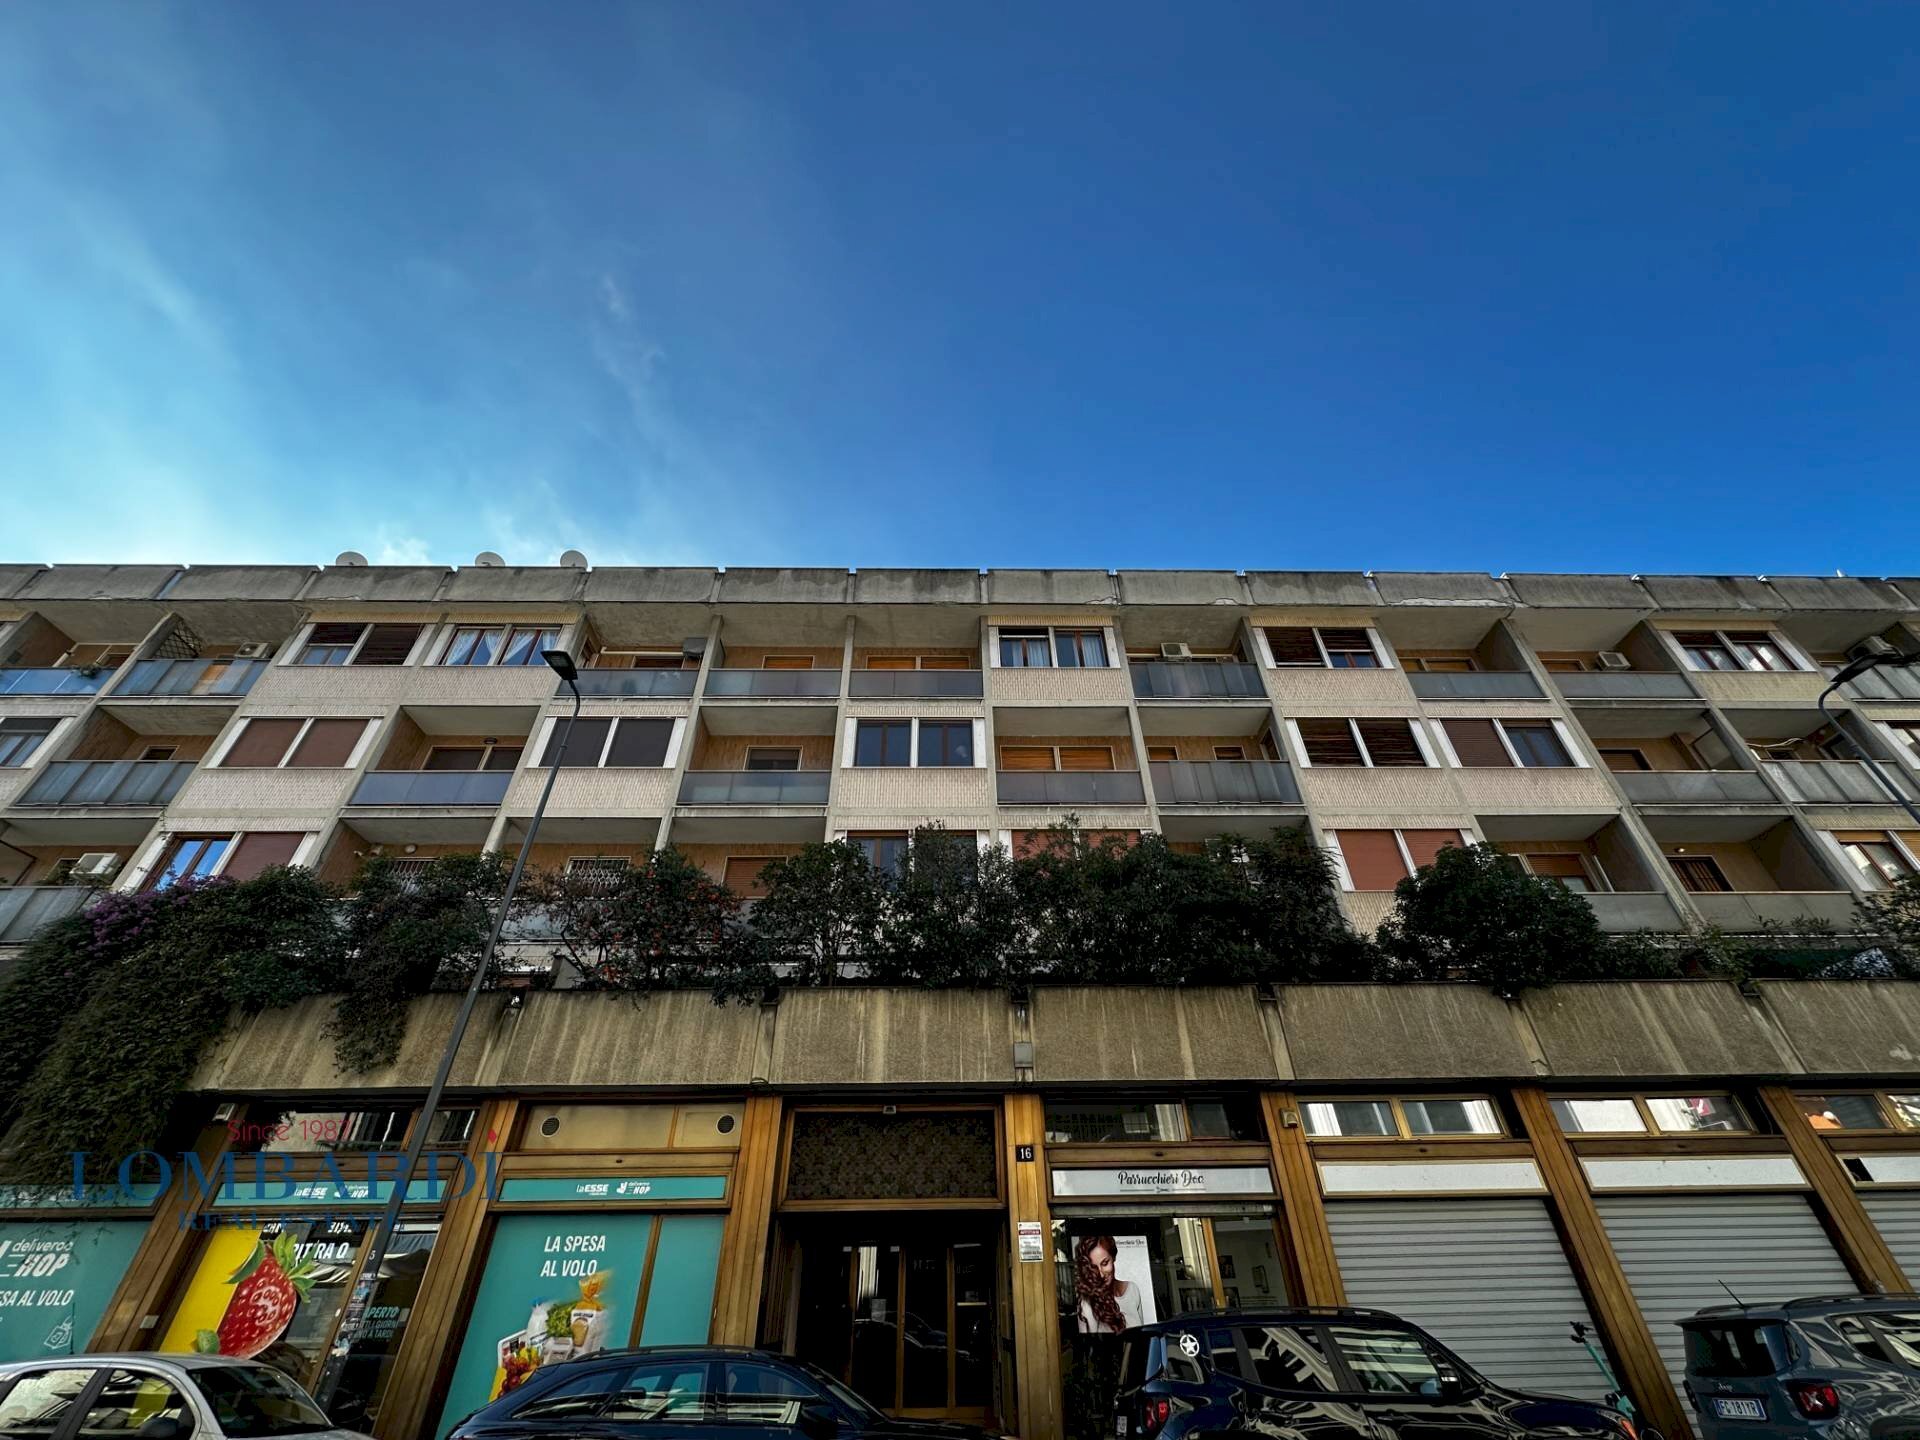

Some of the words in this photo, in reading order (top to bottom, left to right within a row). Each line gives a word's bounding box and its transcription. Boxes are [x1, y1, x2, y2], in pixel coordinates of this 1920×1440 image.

[1020, 1147, 1032, 1159] 16
[1117, 1171, 1178, 1186] Parrucchieri
[633, 1186, 651, 1195] HOP
[12, 1238, 74, 1253] deliveroo
[544, 1236, 561, 1252] LA
[563, 1235, 606, 1252] SPESA
[13, 1253, 71, 1277] HOP
[540, 1260, 557, 1277] AL
[562, 1259, 597, 1277] VOLO
[16, 1289, 36, 1306] AL
[36, 1289, 75, 1306] VOLO
